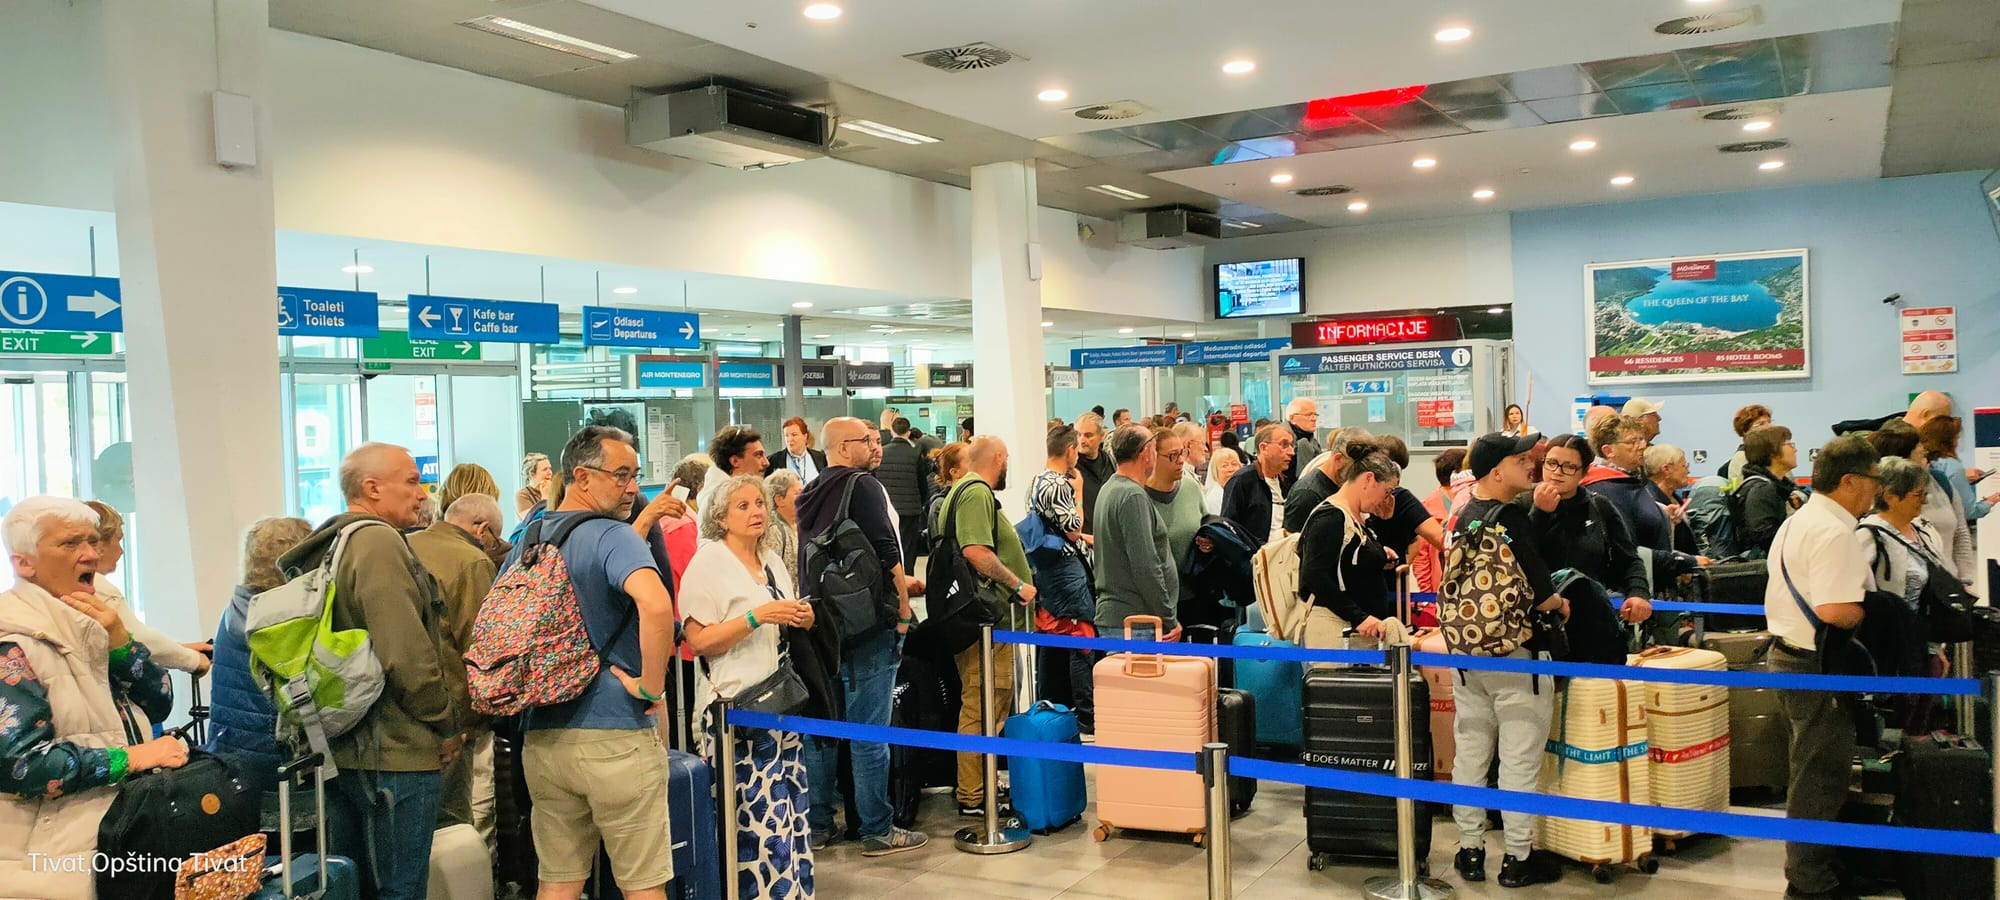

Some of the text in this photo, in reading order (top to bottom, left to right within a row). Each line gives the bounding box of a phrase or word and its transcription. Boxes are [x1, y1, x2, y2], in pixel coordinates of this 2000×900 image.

[303, 299, 345, 313] Toaleti
[1643, 294, 1750, 308] THE QUEEN OF THE BAY
[473, 308, 515, 320] Kafe bar
[303, 314, 345, 327] Toilets
[613, 316, 644, 327] Odlasci
[473, 321, 519, 333] Caffe bar
[1318, 320, 1427, 340] INFORMACIJE
[613, 328, 657, 340] Departures
[2, 337, 39, 351] EXIT
[413, 347, 436, 358] EXIT
[1203, 351, 1242, 360] International
[1321, 350, 1442, 364] PASSENGER SERVICE DESK
[1753, 352, 1784, 360] ROOMS
[1318, 360, 1351, 372] ŠALTER
[1352, 359, 1405, 370] PUTNIČKOG
[1406, 358, 1446, 368] SERVISA
[1635, 356, 1684, 365] RESIDENCES
[641, 371, 701, 379] AIR MONTENEGRO
[1312, 754, 1339, 765] DOES
[1341, 757, 1379, 768] MATTER
[1584, 751, 1611, 761] LIMIT
